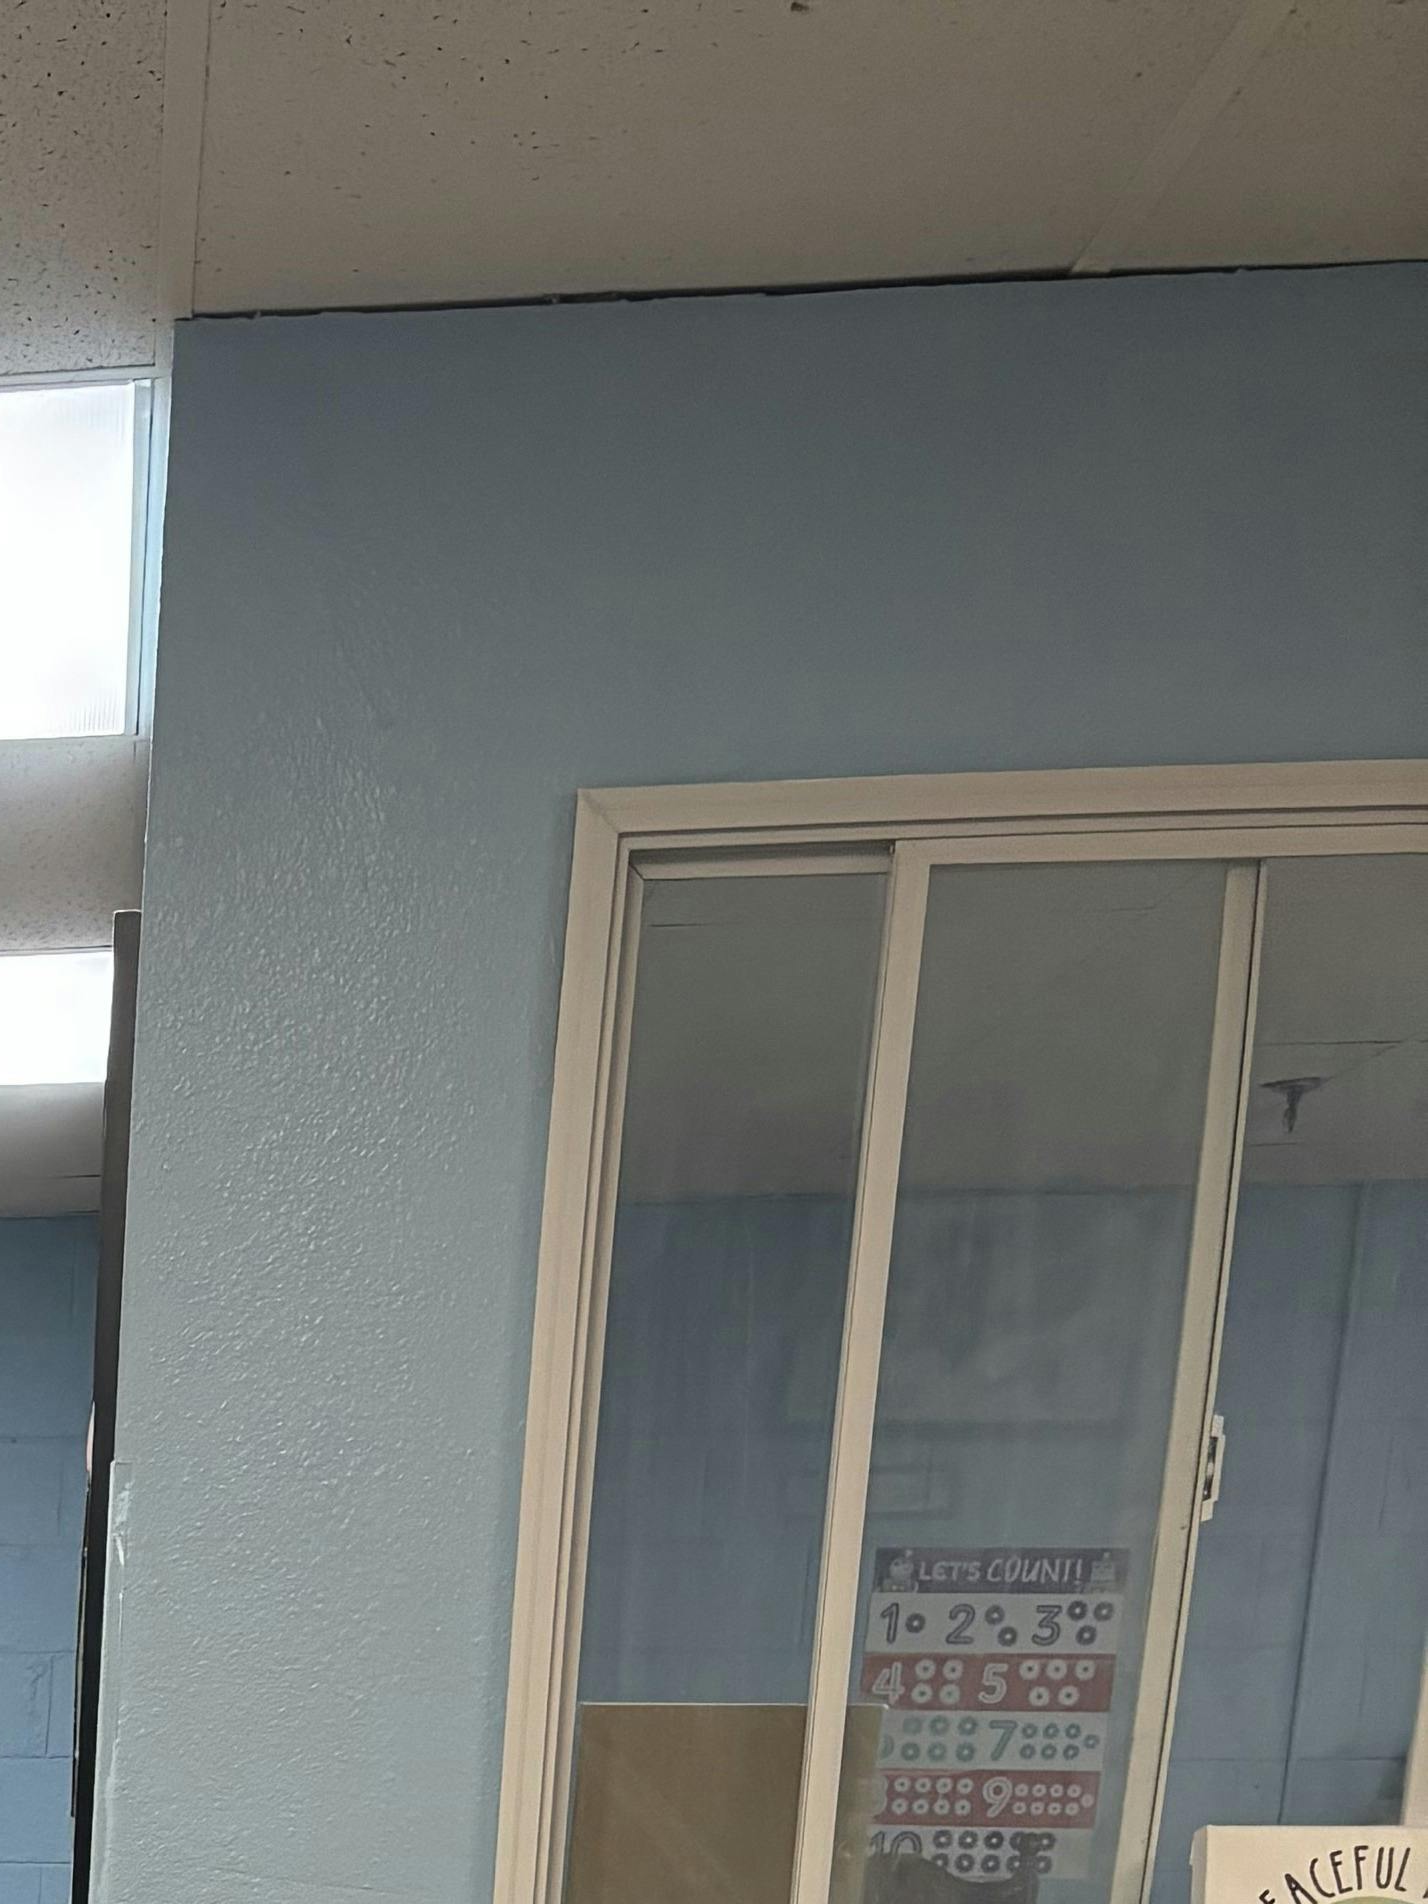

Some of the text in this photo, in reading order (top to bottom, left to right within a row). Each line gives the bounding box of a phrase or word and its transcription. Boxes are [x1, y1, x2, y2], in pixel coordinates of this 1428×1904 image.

[919, 1557, 1083, 1586] LET'S COUNT!
[880, 1602, 1063, 1646] 1 2 3
[871, 1661, 1009, 1703] 4 5
[988, 1720, 1018, 1761] 7
[982, 1776, 1013, 1818] 9
